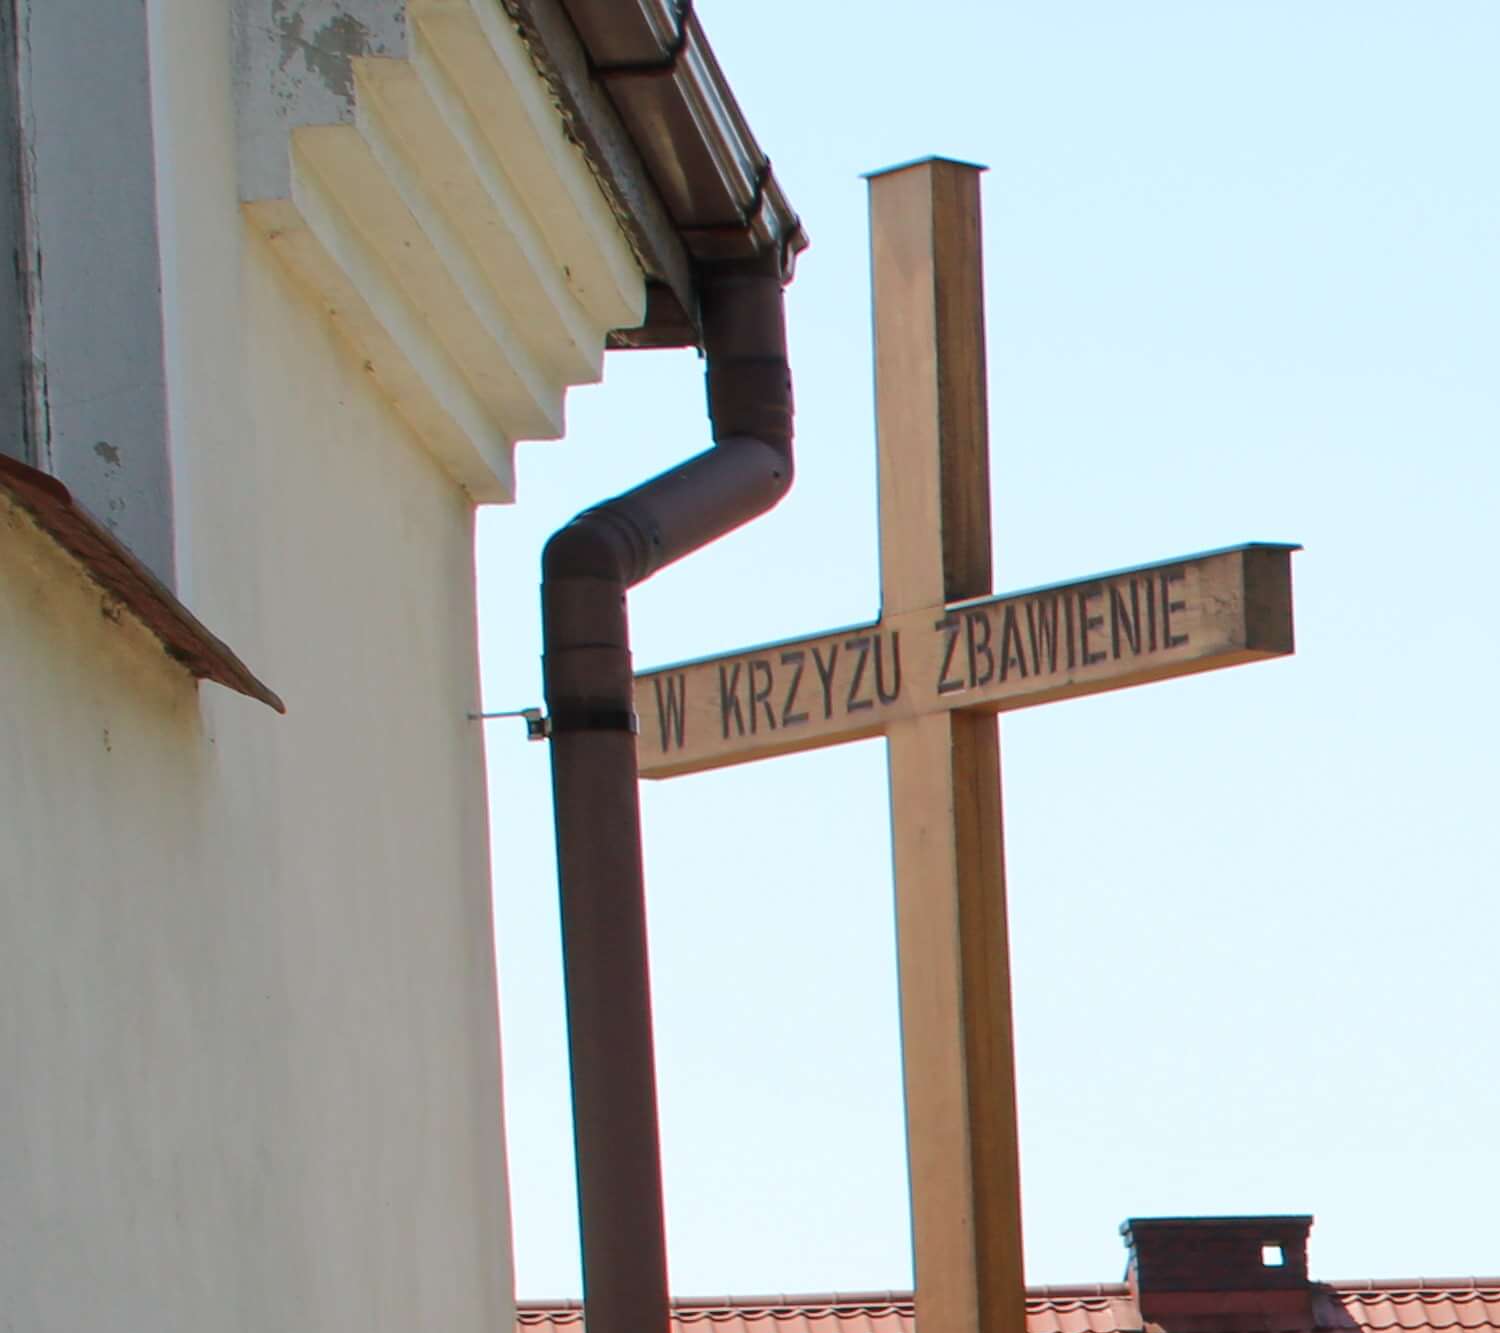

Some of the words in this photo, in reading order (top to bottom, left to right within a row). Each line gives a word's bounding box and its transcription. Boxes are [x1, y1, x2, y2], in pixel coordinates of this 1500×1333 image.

[654, 673, 686, 753] W
[719, 631, 901, 740] KRZYZU
[935, 573, 1190, 695] ZBAWIENIE
